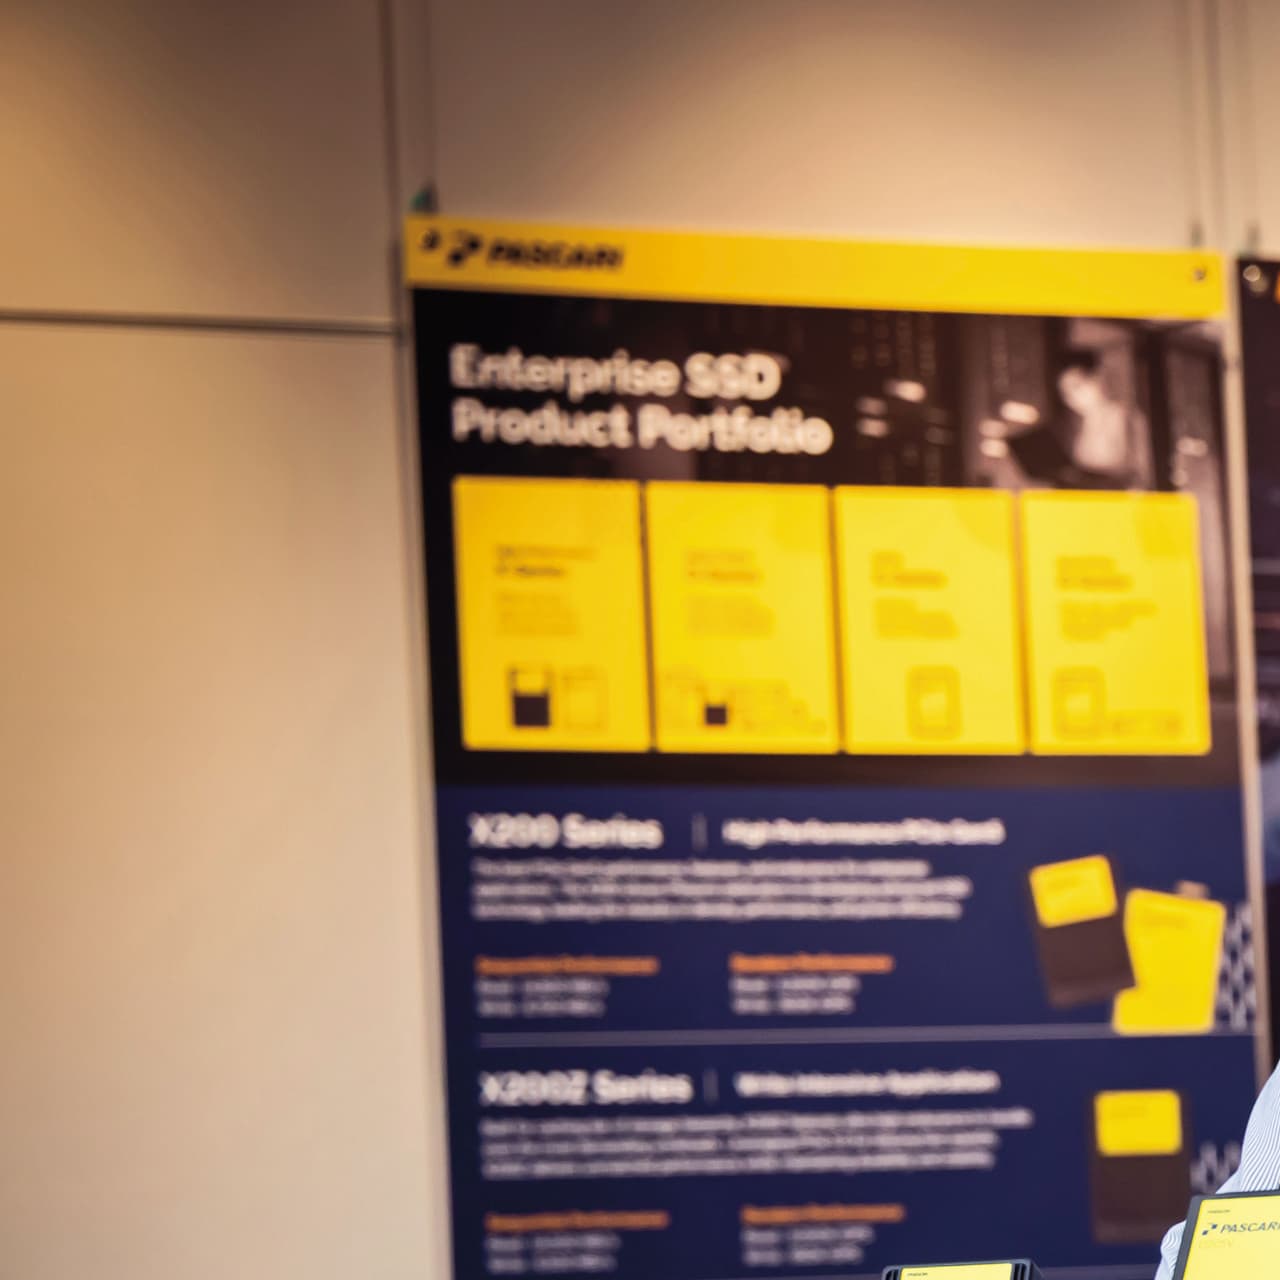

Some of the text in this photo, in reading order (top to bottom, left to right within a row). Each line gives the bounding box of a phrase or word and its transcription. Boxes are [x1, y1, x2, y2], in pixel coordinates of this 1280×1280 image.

[449, 343, 783, 403] Enterprise SSD
[451, 397, 836, 457] Product Portfolio
[562, 812, 664, 849] Series
[592, 1068, 694, 1104] Series
